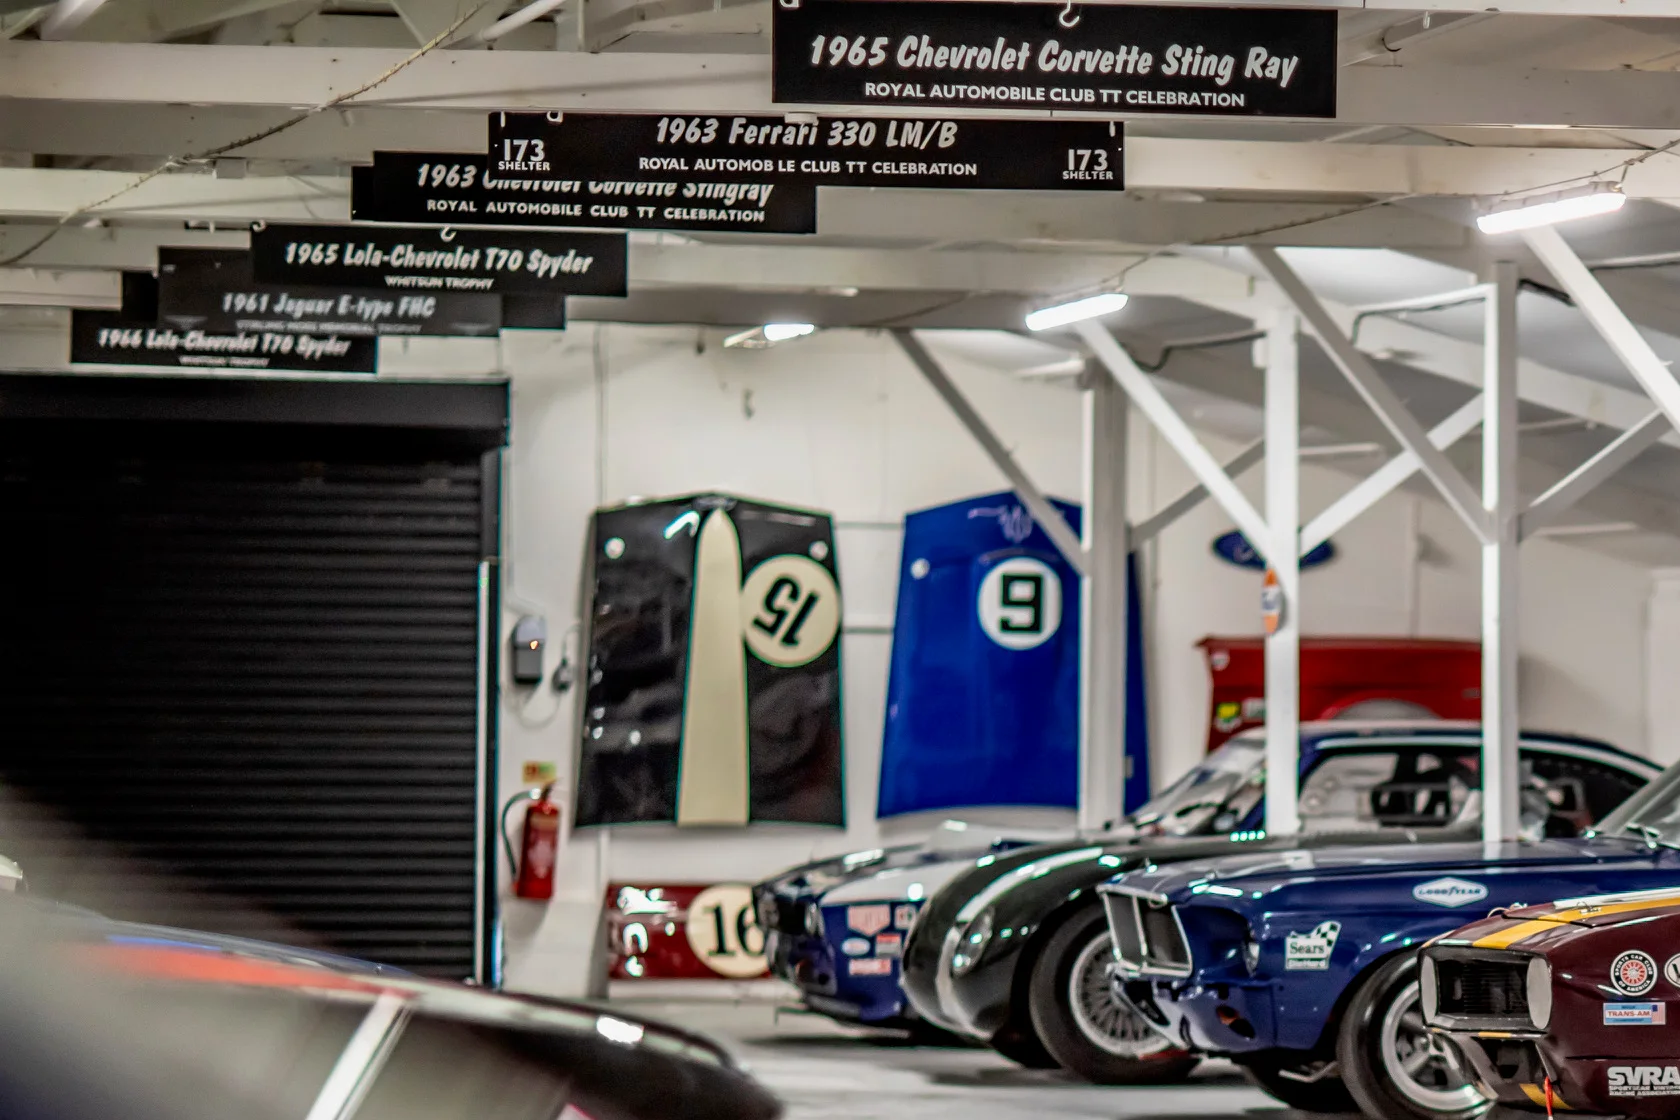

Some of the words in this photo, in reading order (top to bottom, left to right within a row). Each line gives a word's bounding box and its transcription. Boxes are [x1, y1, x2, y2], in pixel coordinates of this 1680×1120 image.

[811, 35, 889, 67] 1965
[897, 35, 1030, 70] Chevrolet
[1038, 39, 1152, 75] Corvette
[1162, 44, 1235, 86] Sting
[1244, 46, 1298, 88] Ray
[865, 82, 925, 98] ROYAL
[930, 84, 1046, 101] AUTOMOBILE
[1050, 87, 1095, 102] CLUB
[1100, 89, 1122, 103] TT
[1126, 90, 1245, 107] CELEBRATION
[656, 117, 719, 144] 1963
[729, 117, 818, 146] Ferrari
[827, 120, 876, 147] 330
[885, 120, 959, 150] LM/B
[503, 139, 546, 161] 173
[1068, 149, 1108, 171] 173
[417, 163, 477, 188] 1963
[498, 161, 550, 171] SHELTER
[639, 157, 689, 171] ROYAL
[694, 158, 795, 173] AUTOMOBLE
[800, 160, 840, 173] CLUB
[846, 161, 867, 174] TT
[872, 161, 978, 176] CELEBRATION
[1062, 170, 1114, 180] SHELTER
[427, 200, 477, 212] ROYAL
[485, 201, 582, 216] AUTOMOBILE
[590, 204, 629, 218] CLUB
[637, 206, 656, 219] TT
[664, 207, 765, 223] CELEBRATION
[286, 242, 340, 265] 1965
[344, 243, 481, 270] Lola-Chevrolet
[485, 249, 523, 271] T70
[528, 249, 593, 278] Spyder
[223, 293, 270, 313] 1961
[273, 293, 335, 319] Jaguar
[702, 904, 766, 956] 16
[1290, 942, 1324, 954] Sears
